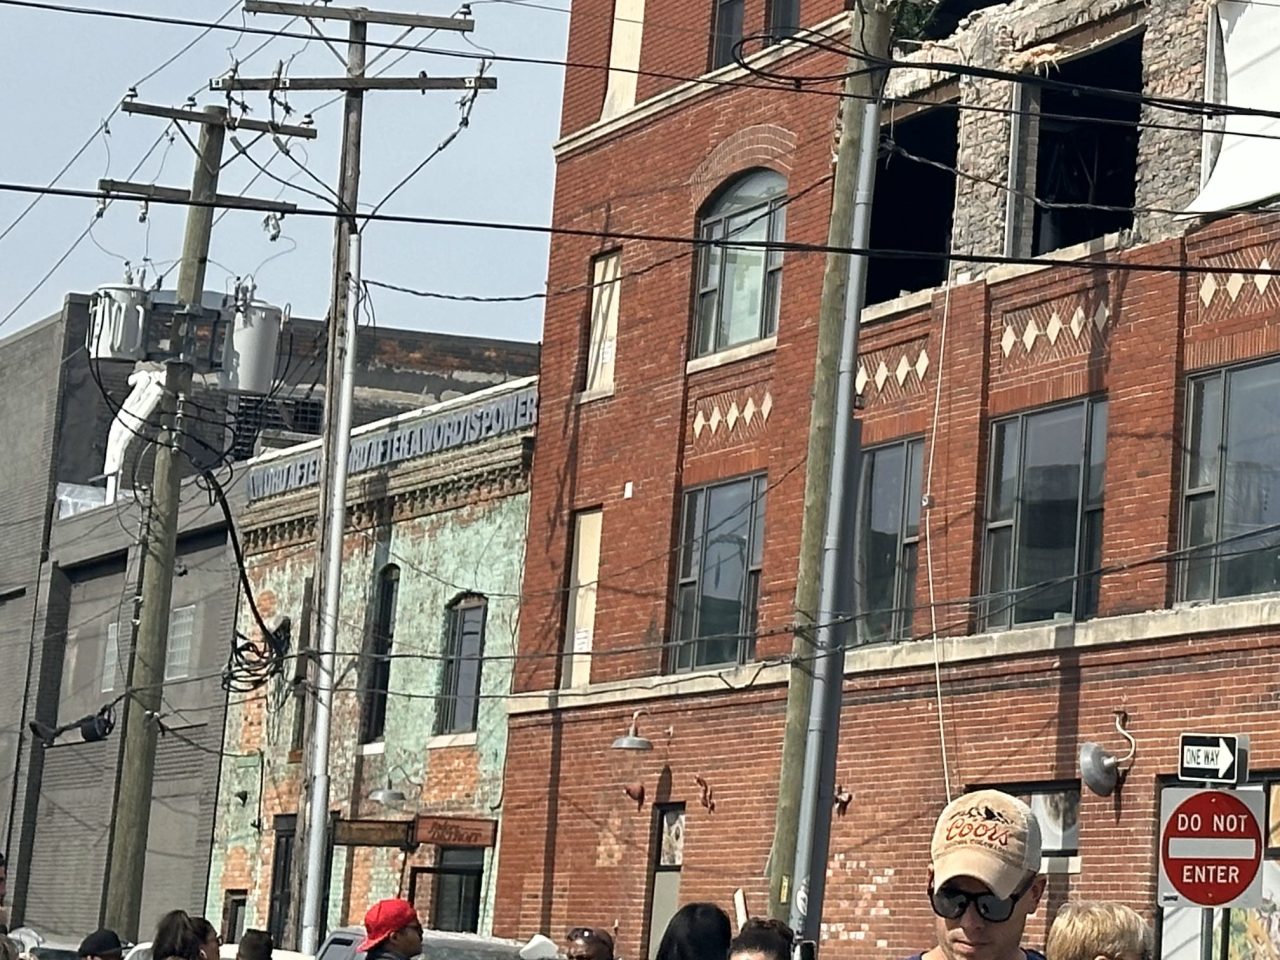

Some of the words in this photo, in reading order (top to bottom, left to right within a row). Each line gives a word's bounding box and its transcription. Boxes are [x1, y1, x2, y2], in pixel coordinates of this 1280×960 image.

[1186, 748, 1202, 765] ONE
[1203, 749, 1220, 766] WAY
[945, 818, 1010, 847] Coors
[1177, 813, 1202, 831] DO
[1213, 814, 1249, 833] NOT
[1182, 865, 1240, 883] ENTER
